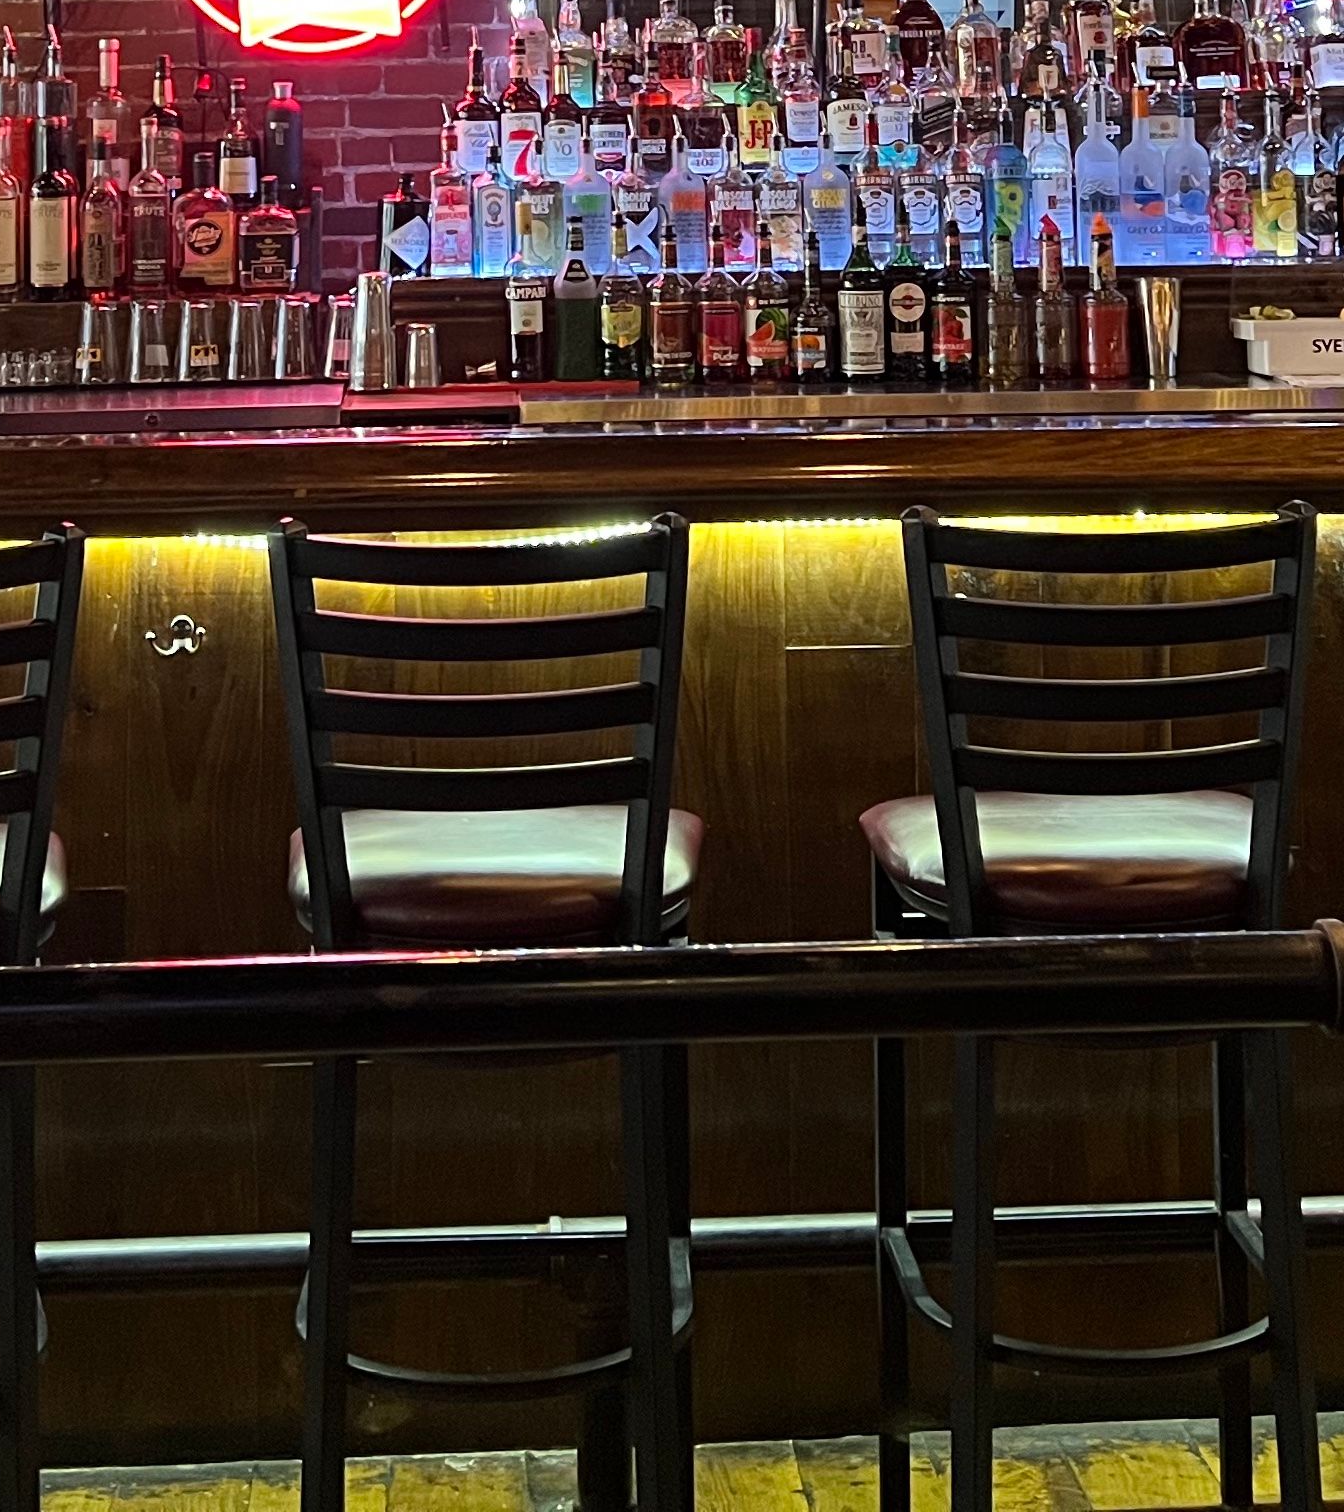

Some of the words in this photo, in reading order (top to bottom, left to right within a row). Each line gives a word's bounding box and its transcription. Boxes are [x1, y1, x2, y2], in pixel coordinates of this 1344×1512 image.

[832, 102, 869, 114] JAMESO
[508, 129, 537, 176] 7
[506, 286, 546, 299] CAMPARI
